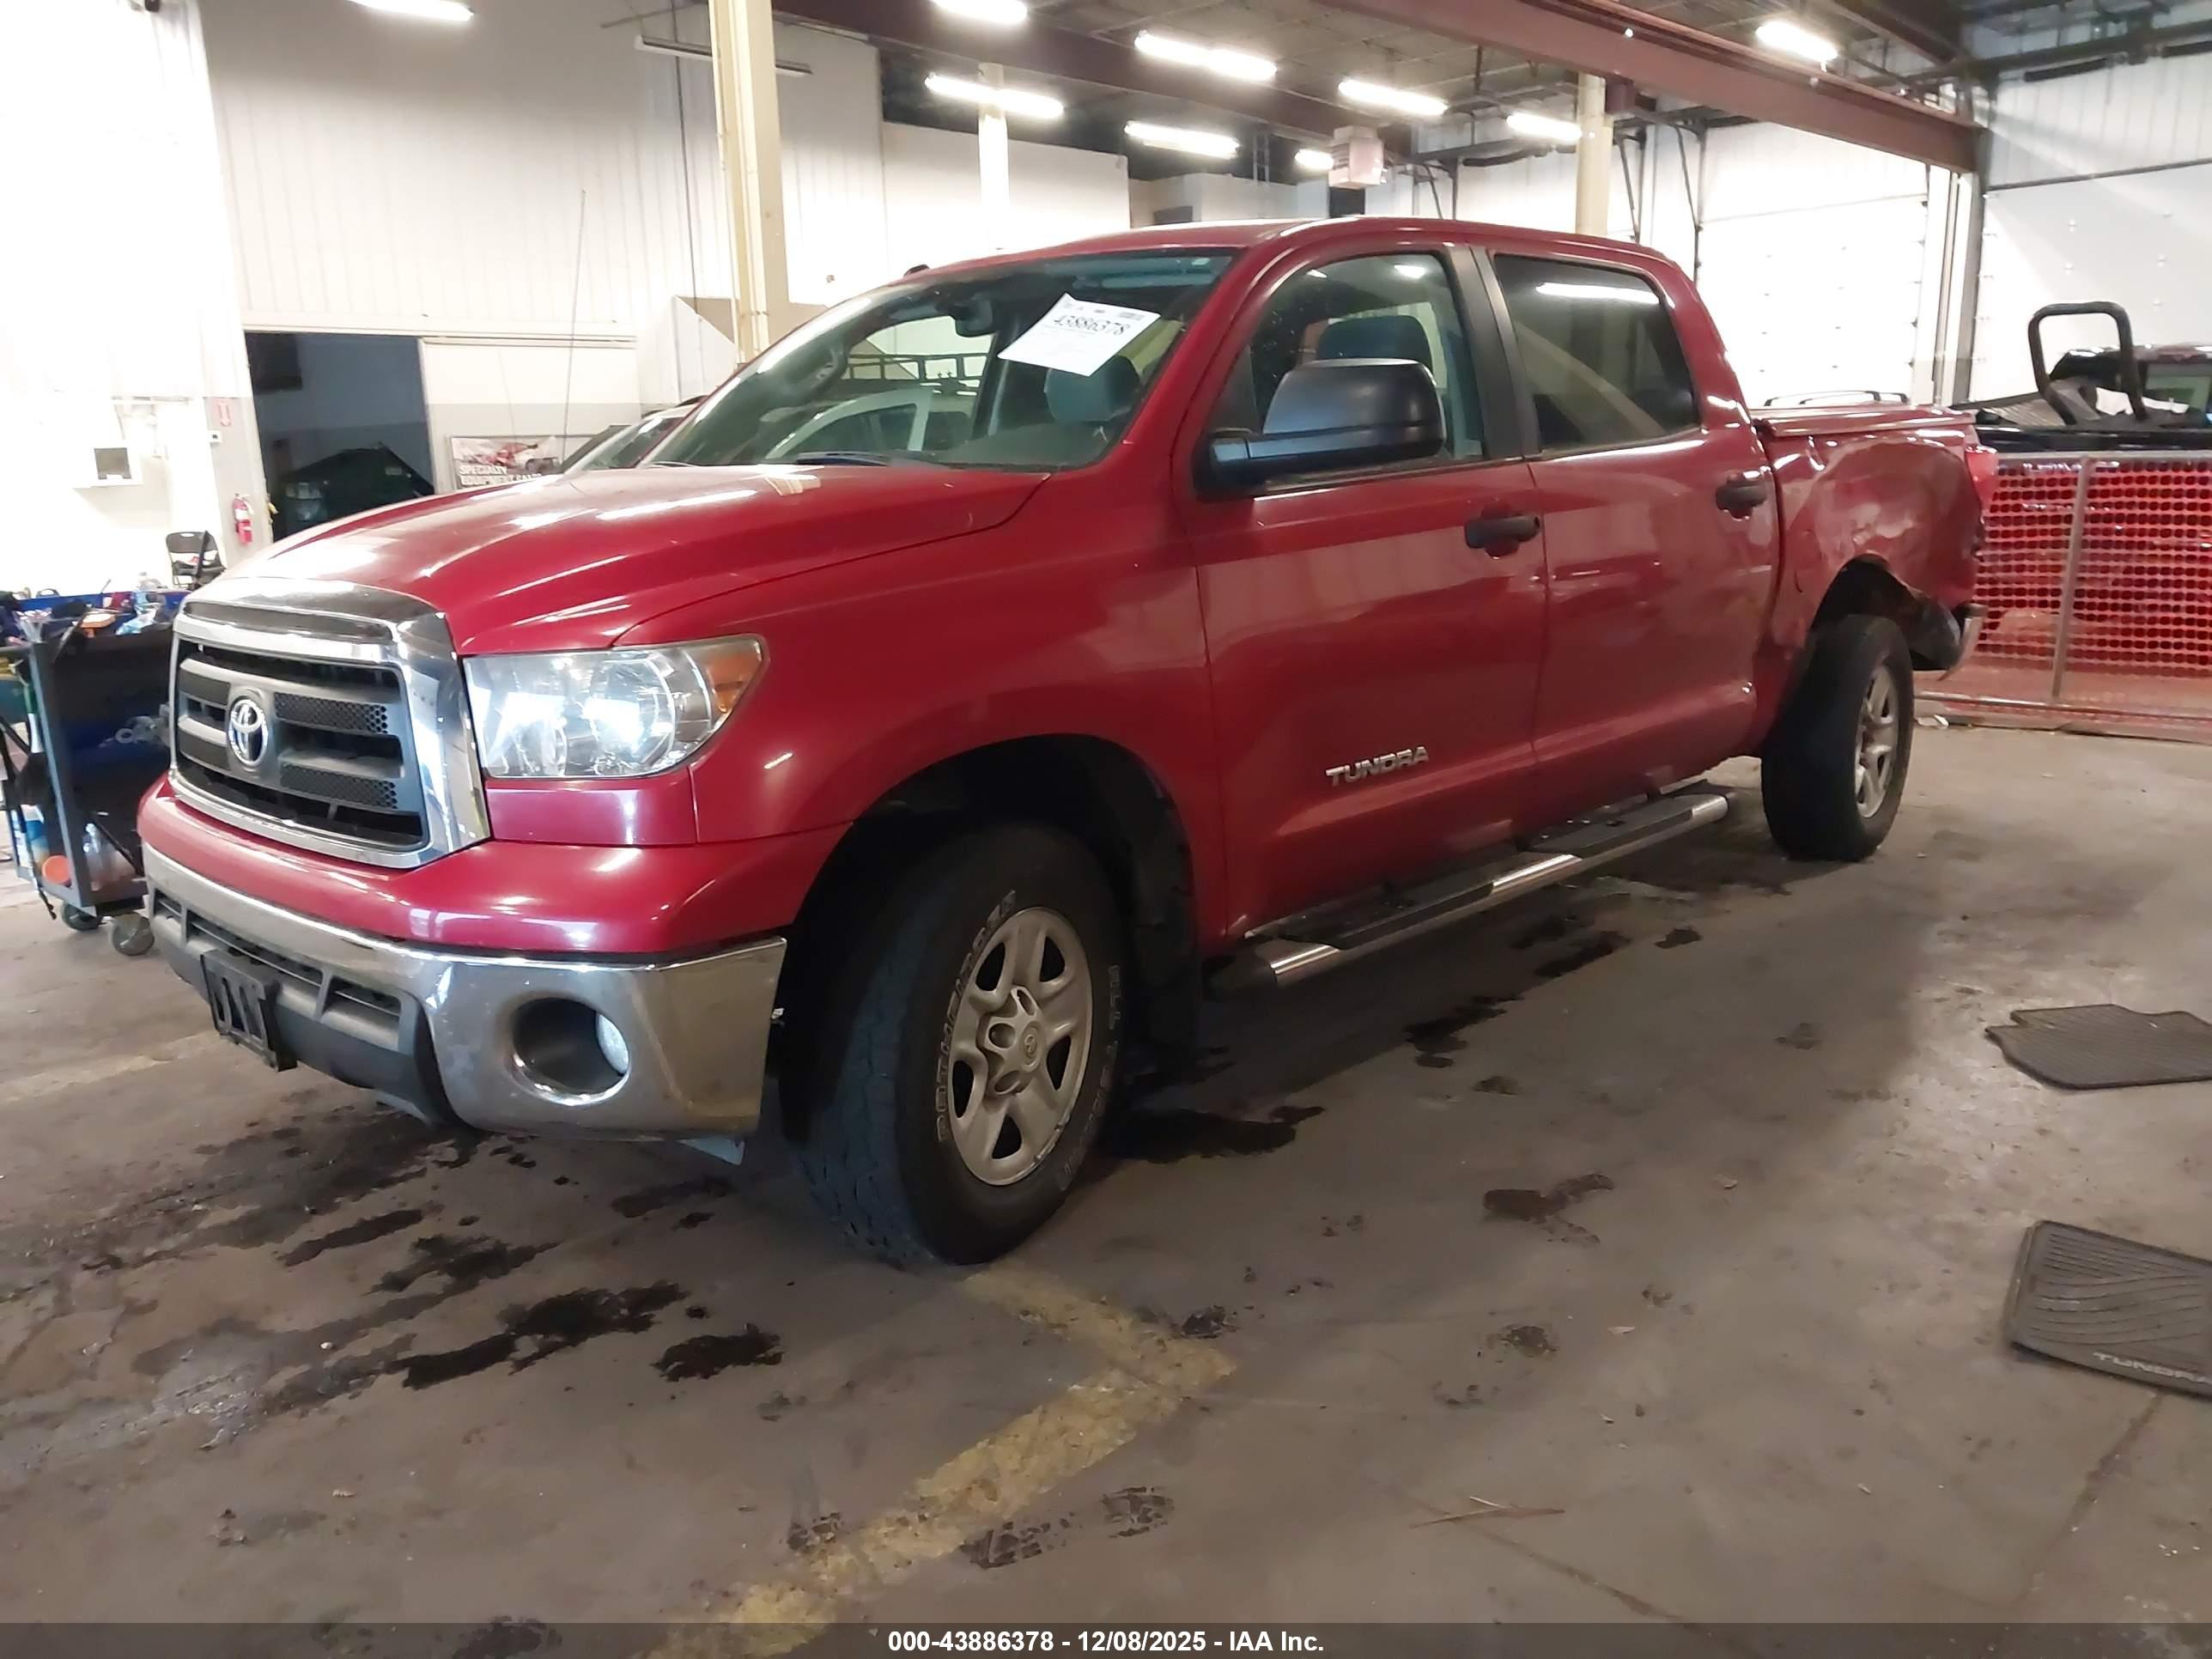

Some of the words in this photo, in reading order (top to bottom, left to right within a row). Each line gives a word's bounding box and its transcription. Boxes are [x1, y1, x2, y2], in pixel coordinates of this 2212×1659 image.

[1054, 314, 1131, 336] 43886378
[459, 465, 508, 475] SPECIALTY
[1326, 745, 1429, 787] TUNDRA
